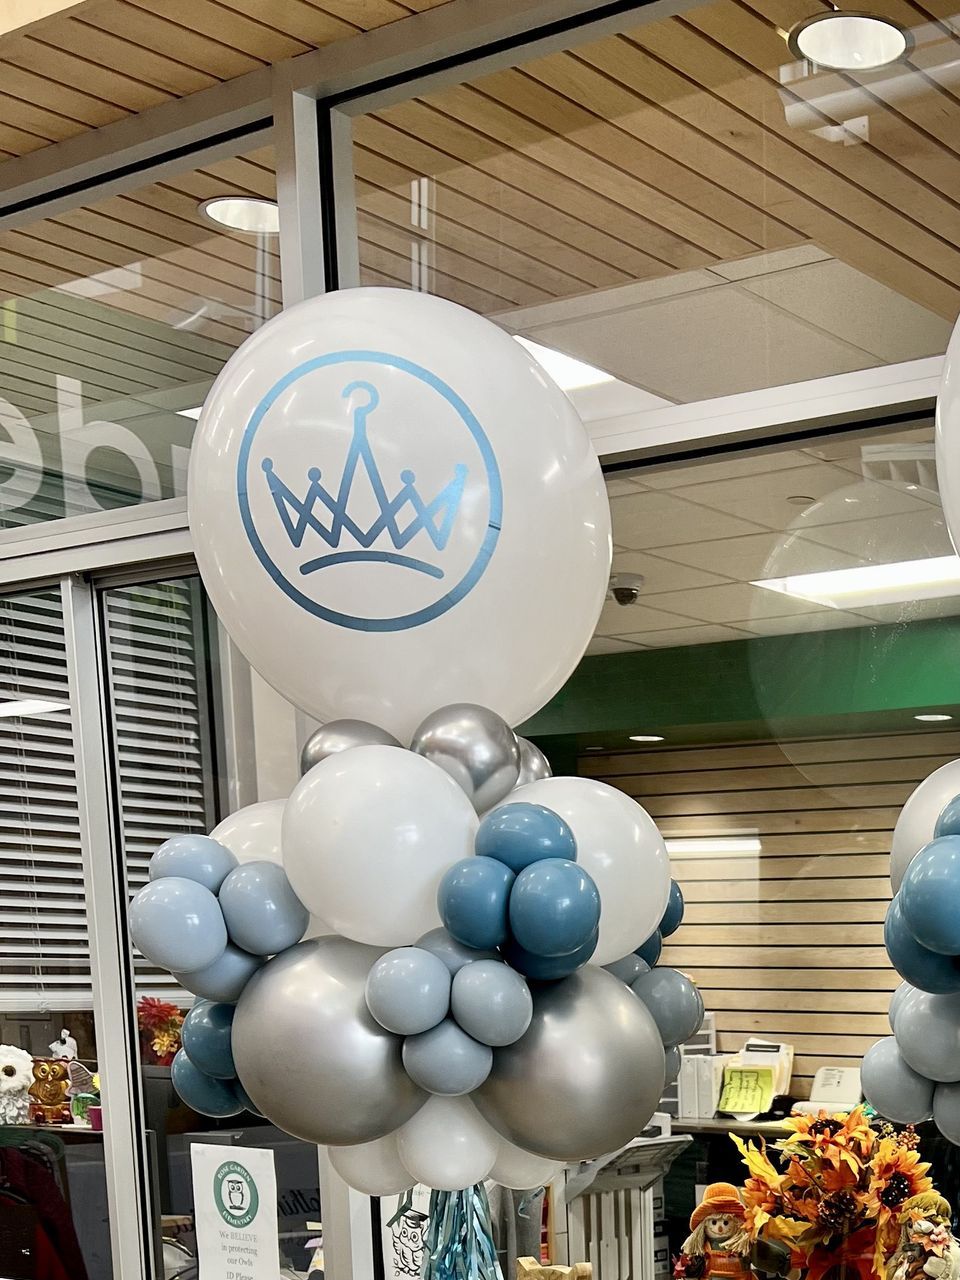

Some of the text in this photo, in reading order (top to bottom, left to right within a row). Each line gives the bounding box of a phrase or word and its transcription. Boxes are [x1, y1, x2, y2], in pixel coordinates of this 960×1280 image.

[229, 1164, 252, 1182] GARDEN
[222, 1210, 252, 1226] ELEMENTARY
[219, 1230, 258, 1243] We BELIEVE
[221, 1242, 258, 1257] in protecting
[238, 1257, 253, 1267] Owls
[226, 1271, 235, 1280] ID
